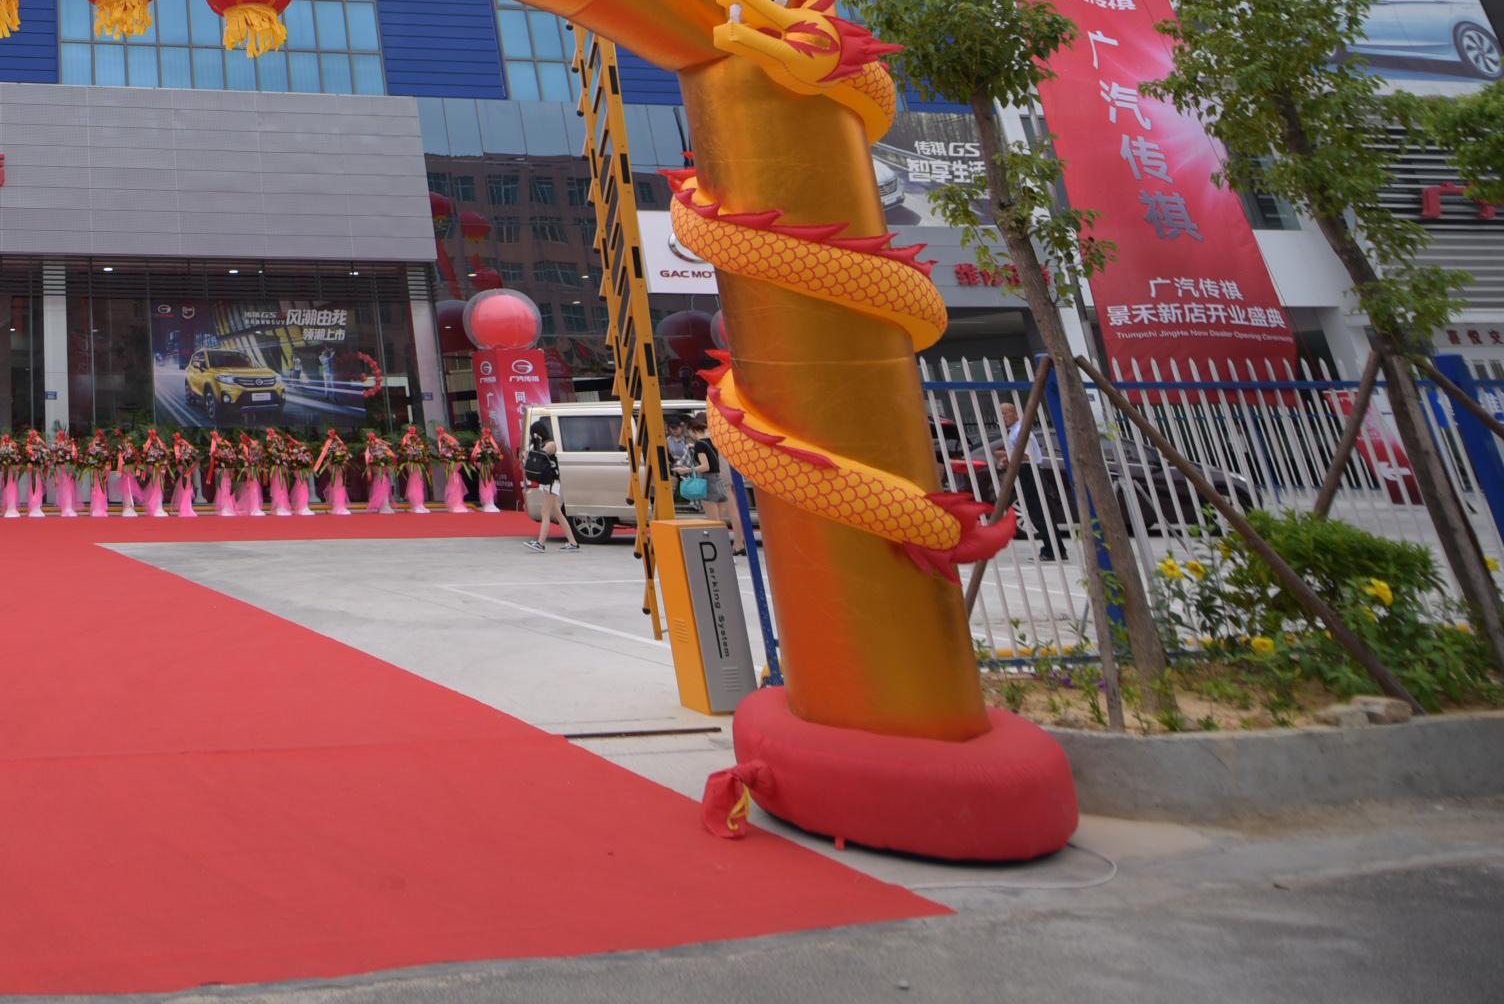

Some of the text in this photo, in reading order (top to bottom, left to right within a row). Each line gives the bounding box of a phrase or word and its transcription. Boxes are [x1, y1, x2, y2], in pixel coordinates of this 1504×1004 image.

[1087, 30, 1202, 241] 广汽传祺
[659, 269, 690, 278] GAC
[1148, 277, 1244, 301] 广汽传祺
[1106, 302, 1288, 330] 景禾新店开业盛典
